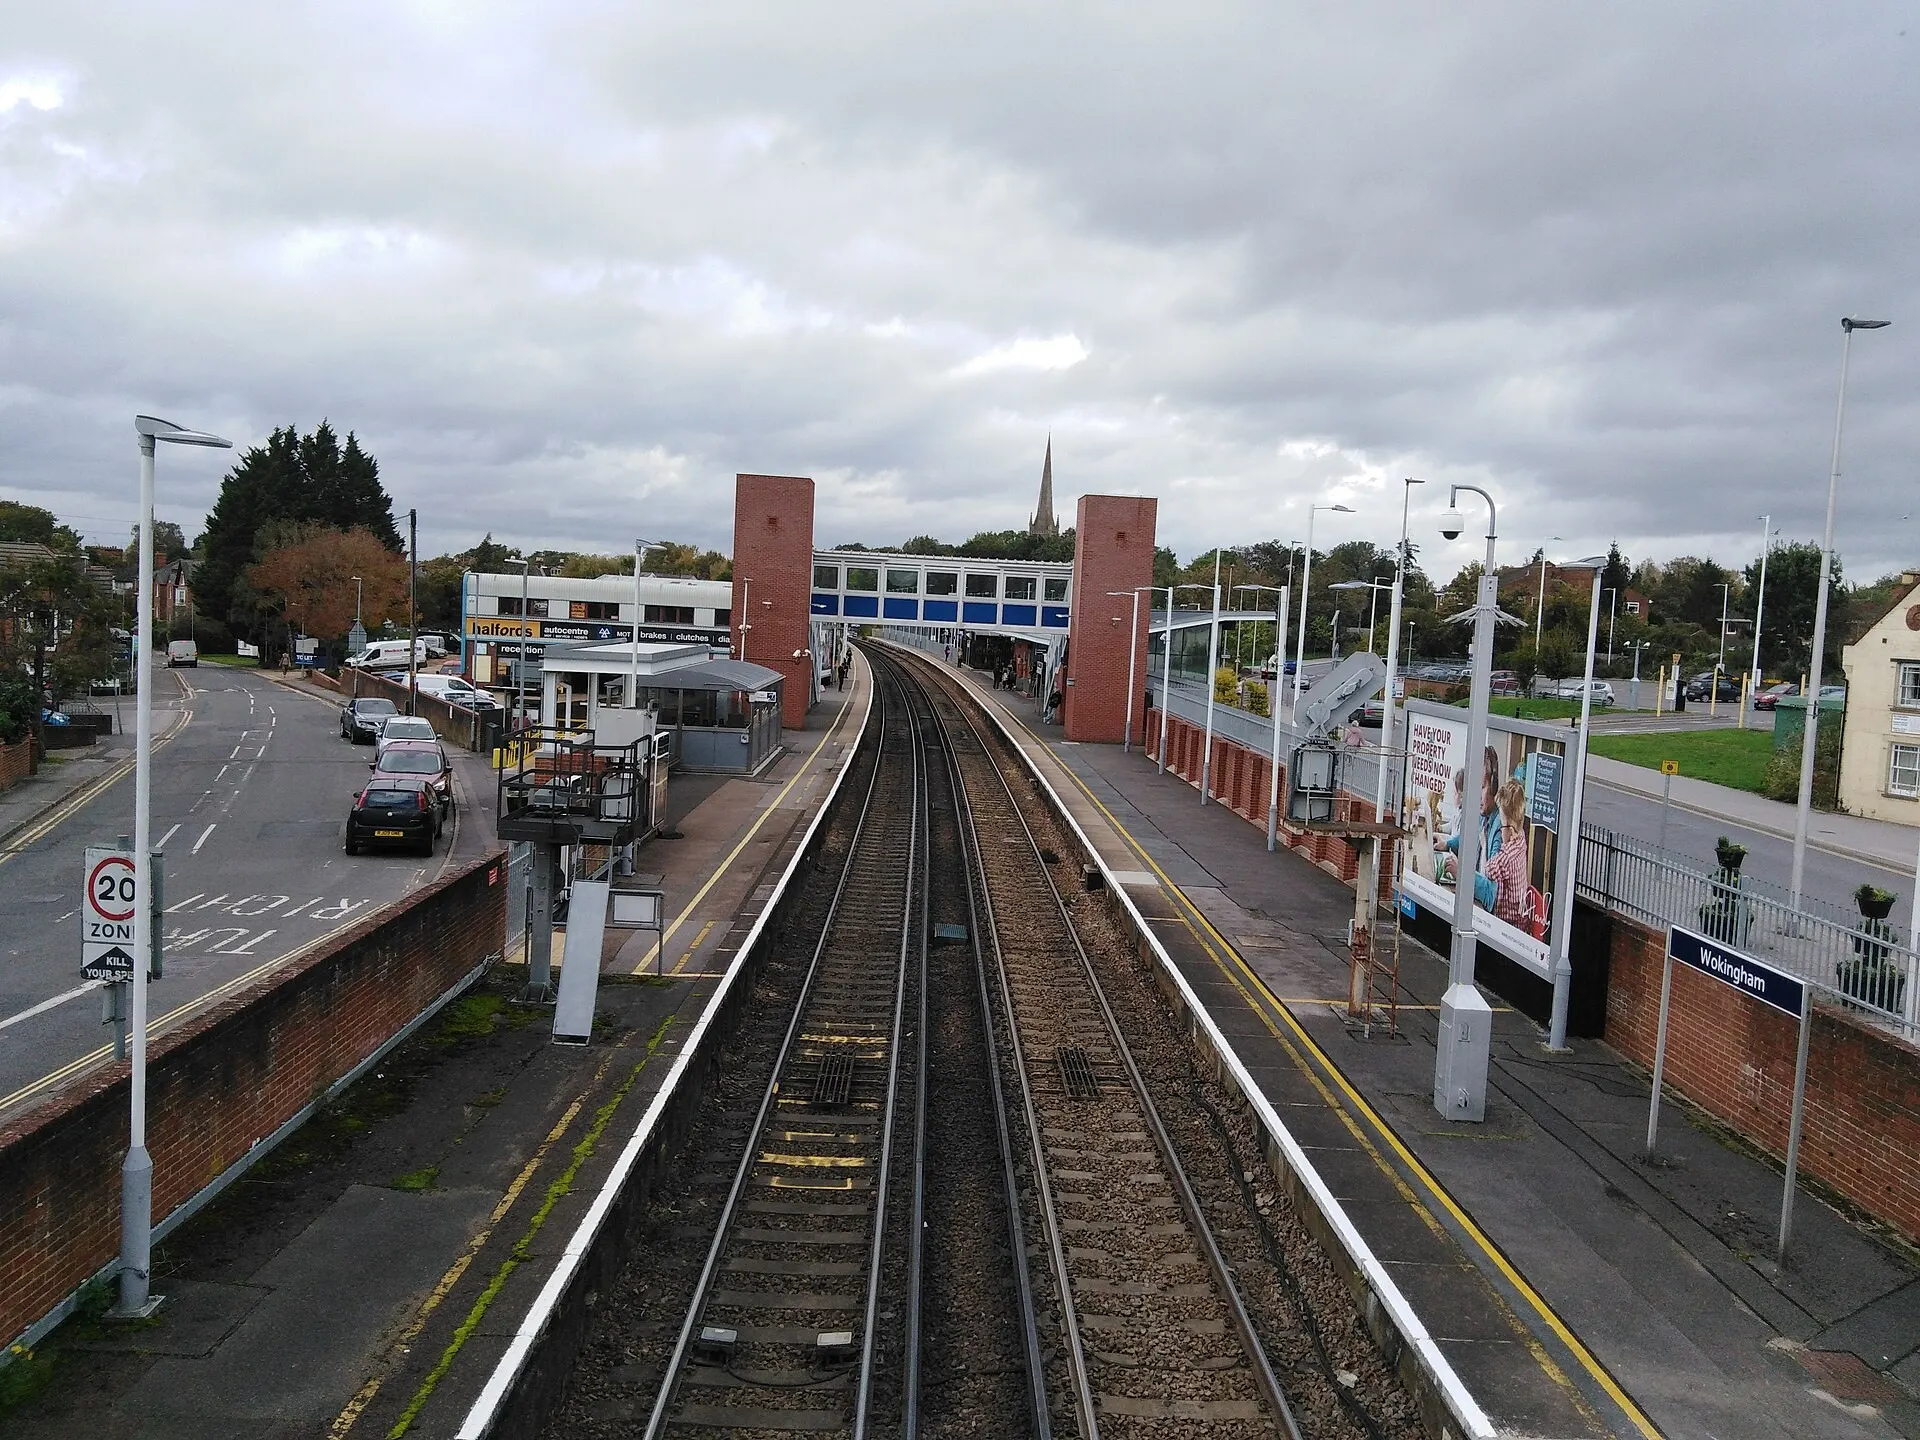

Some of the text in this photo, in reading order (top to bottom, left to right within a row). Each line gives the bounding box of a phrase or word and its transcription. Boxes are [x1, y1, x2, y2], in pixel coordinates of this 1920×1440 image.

[472, 622, 533, 637] halfords
[543, 626, 589, 635] autocentre
[640, 631, 667, 640] brakes
[676, 633, 709, 642] clutches
[718, 635, 731, 643] dia
[501, 645, 543, 654] recetion
[1413, 723, 1452, 745] HAVE YOUR
[1412, 739, 1446, 760] PROPERTY
[1412, 756, 1452, 779] NEEDS NOW
[98, 875, 135, 902] 20
[90, 923, 135, 939] ZON
[162, 927, 277, 955] TUR
[85, 968, 134, 980] YOUR SPE
[1700, 946, 1765, 993] Wokingham
